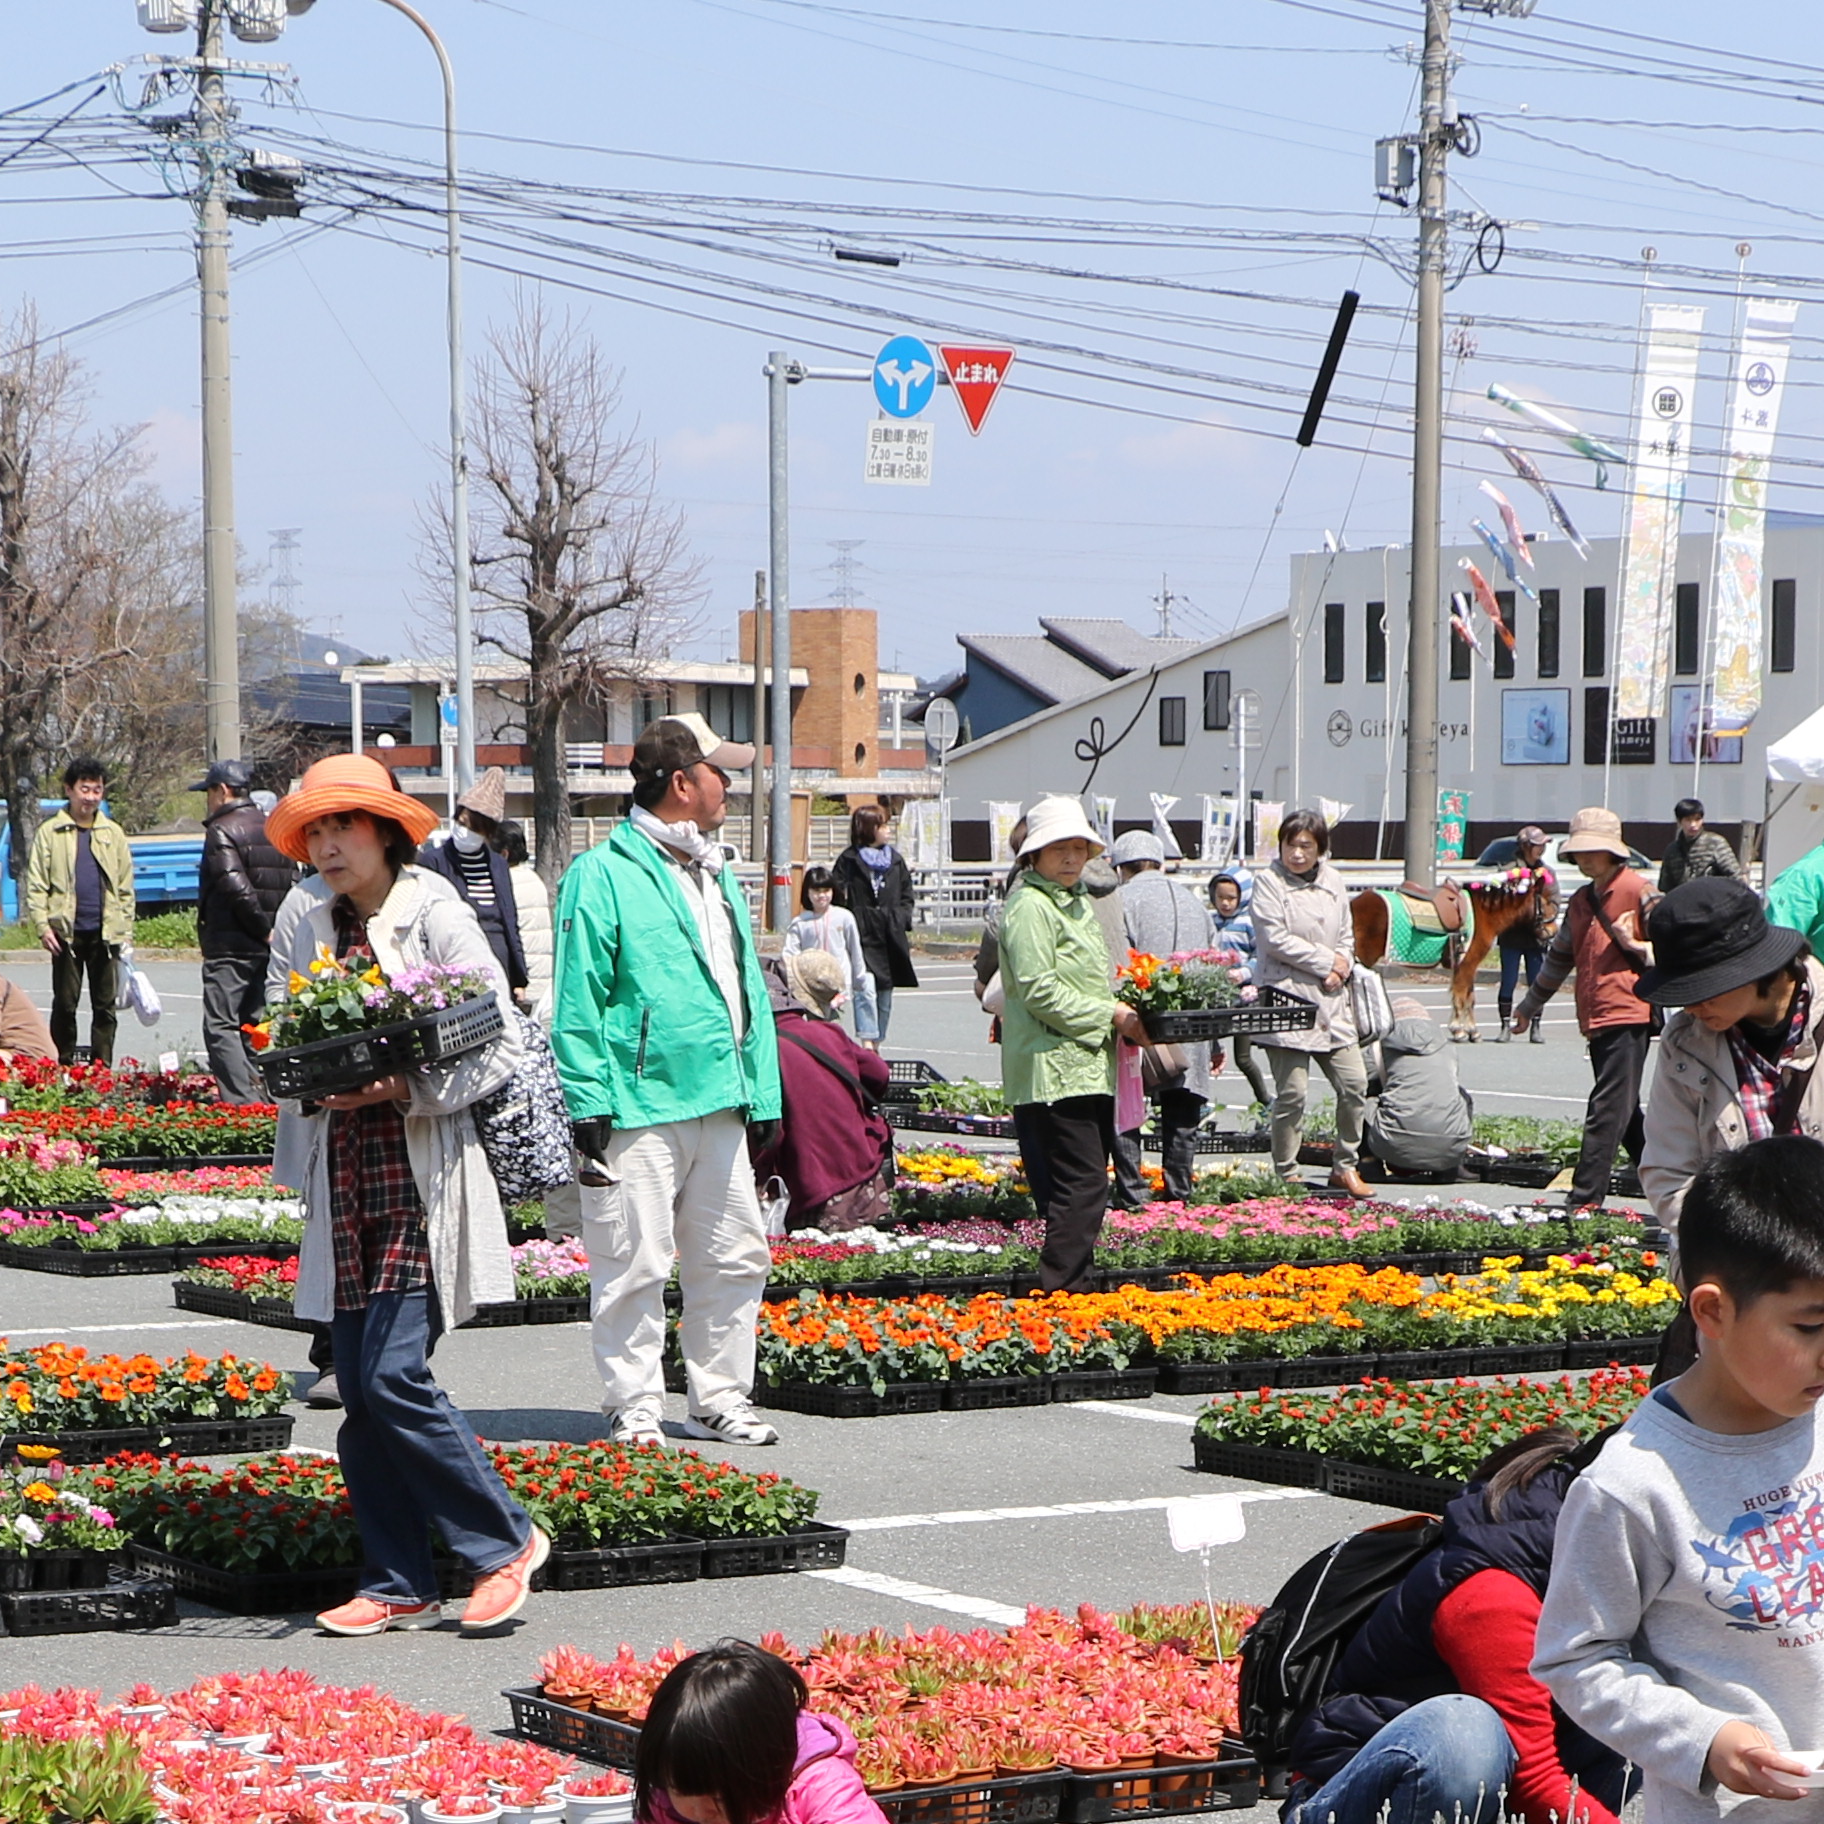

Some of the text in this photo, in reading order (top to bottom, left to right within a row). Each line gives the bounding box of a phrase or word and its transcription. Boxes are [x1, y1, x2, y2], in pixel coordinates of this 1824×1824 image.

[954, 361, 999, 383] 止まれ
[1401, 721, 1469, 738] keya
[1614, 717, 1651, 735] Gift
[1742, 1484, 1792, 1512] HUGE
[1776, 1629, 1824, 1648] MANY
